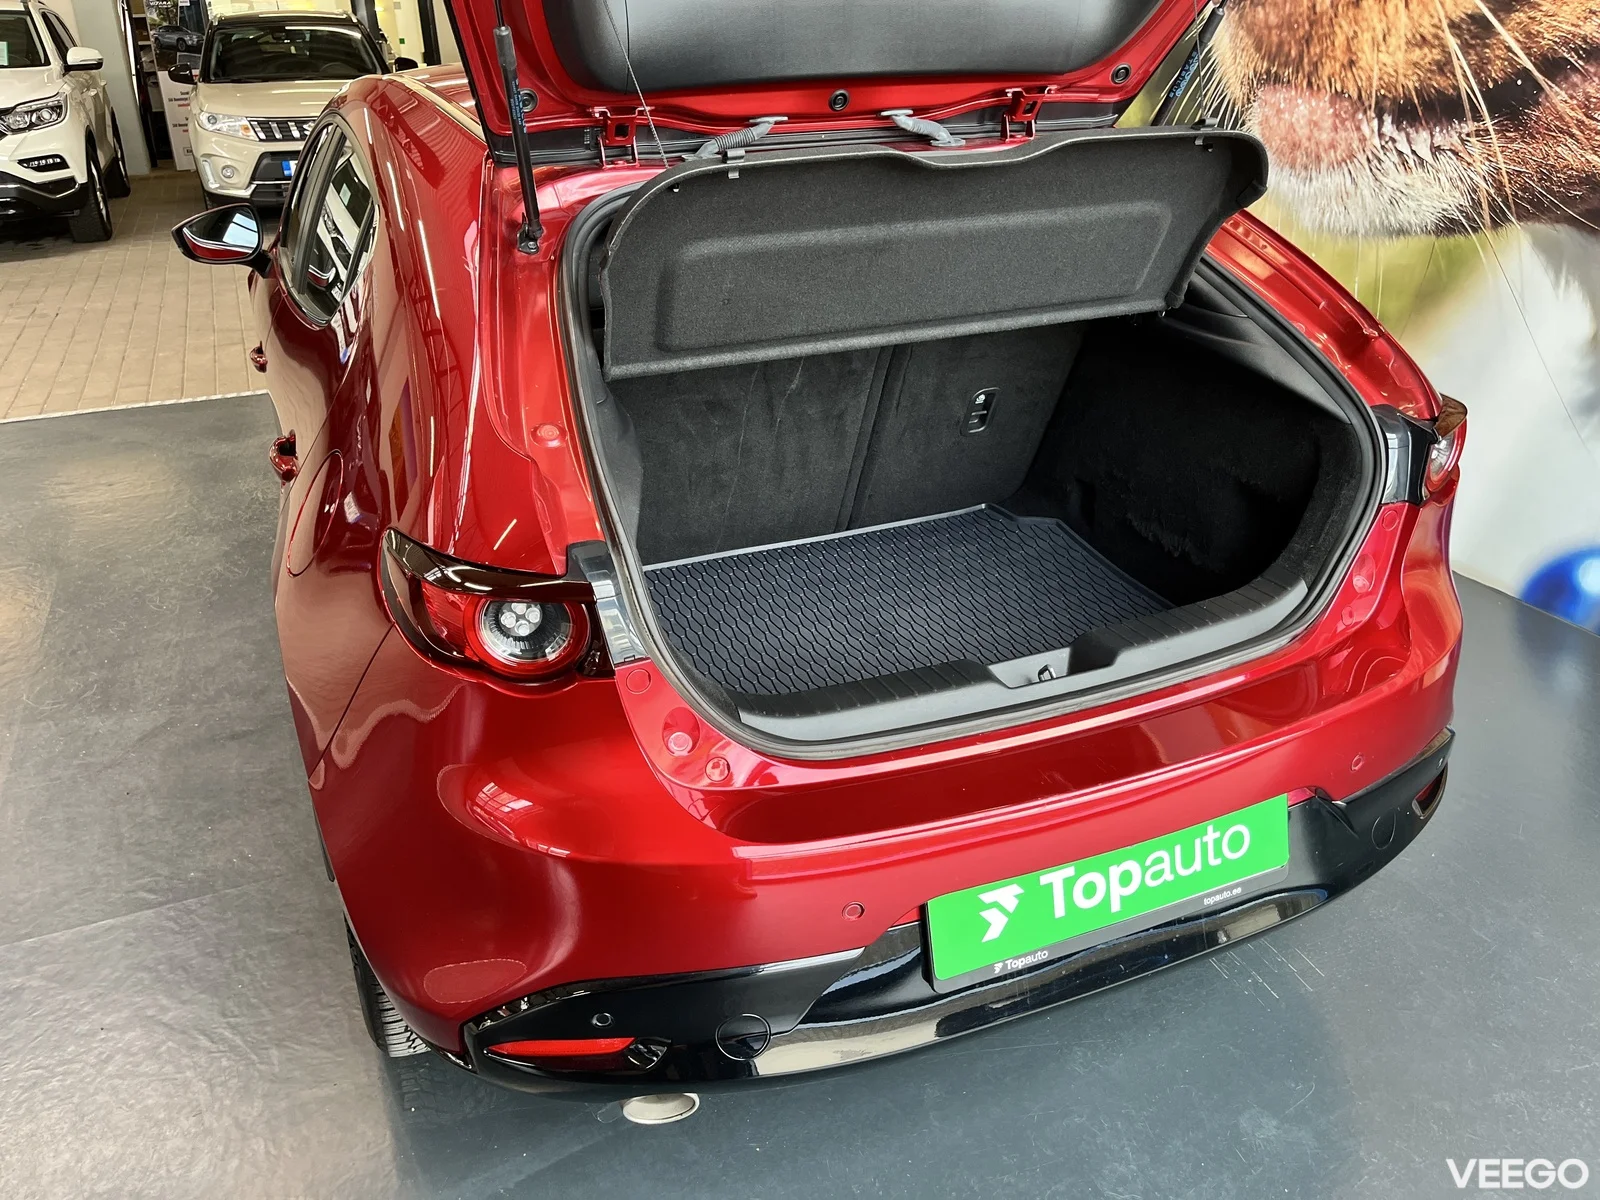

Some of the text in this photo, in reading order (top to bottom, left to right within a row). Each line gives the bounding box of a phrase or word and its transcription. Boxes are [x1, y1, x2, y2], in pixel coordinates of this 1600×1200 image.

[1169, 51, 1197, 98] STABILUS
[1039, 824, 1251, 919] Topauto
[1203, 886, 1242, 906] topauto.ee
[1004, 950, 1048, 970] Topauto
